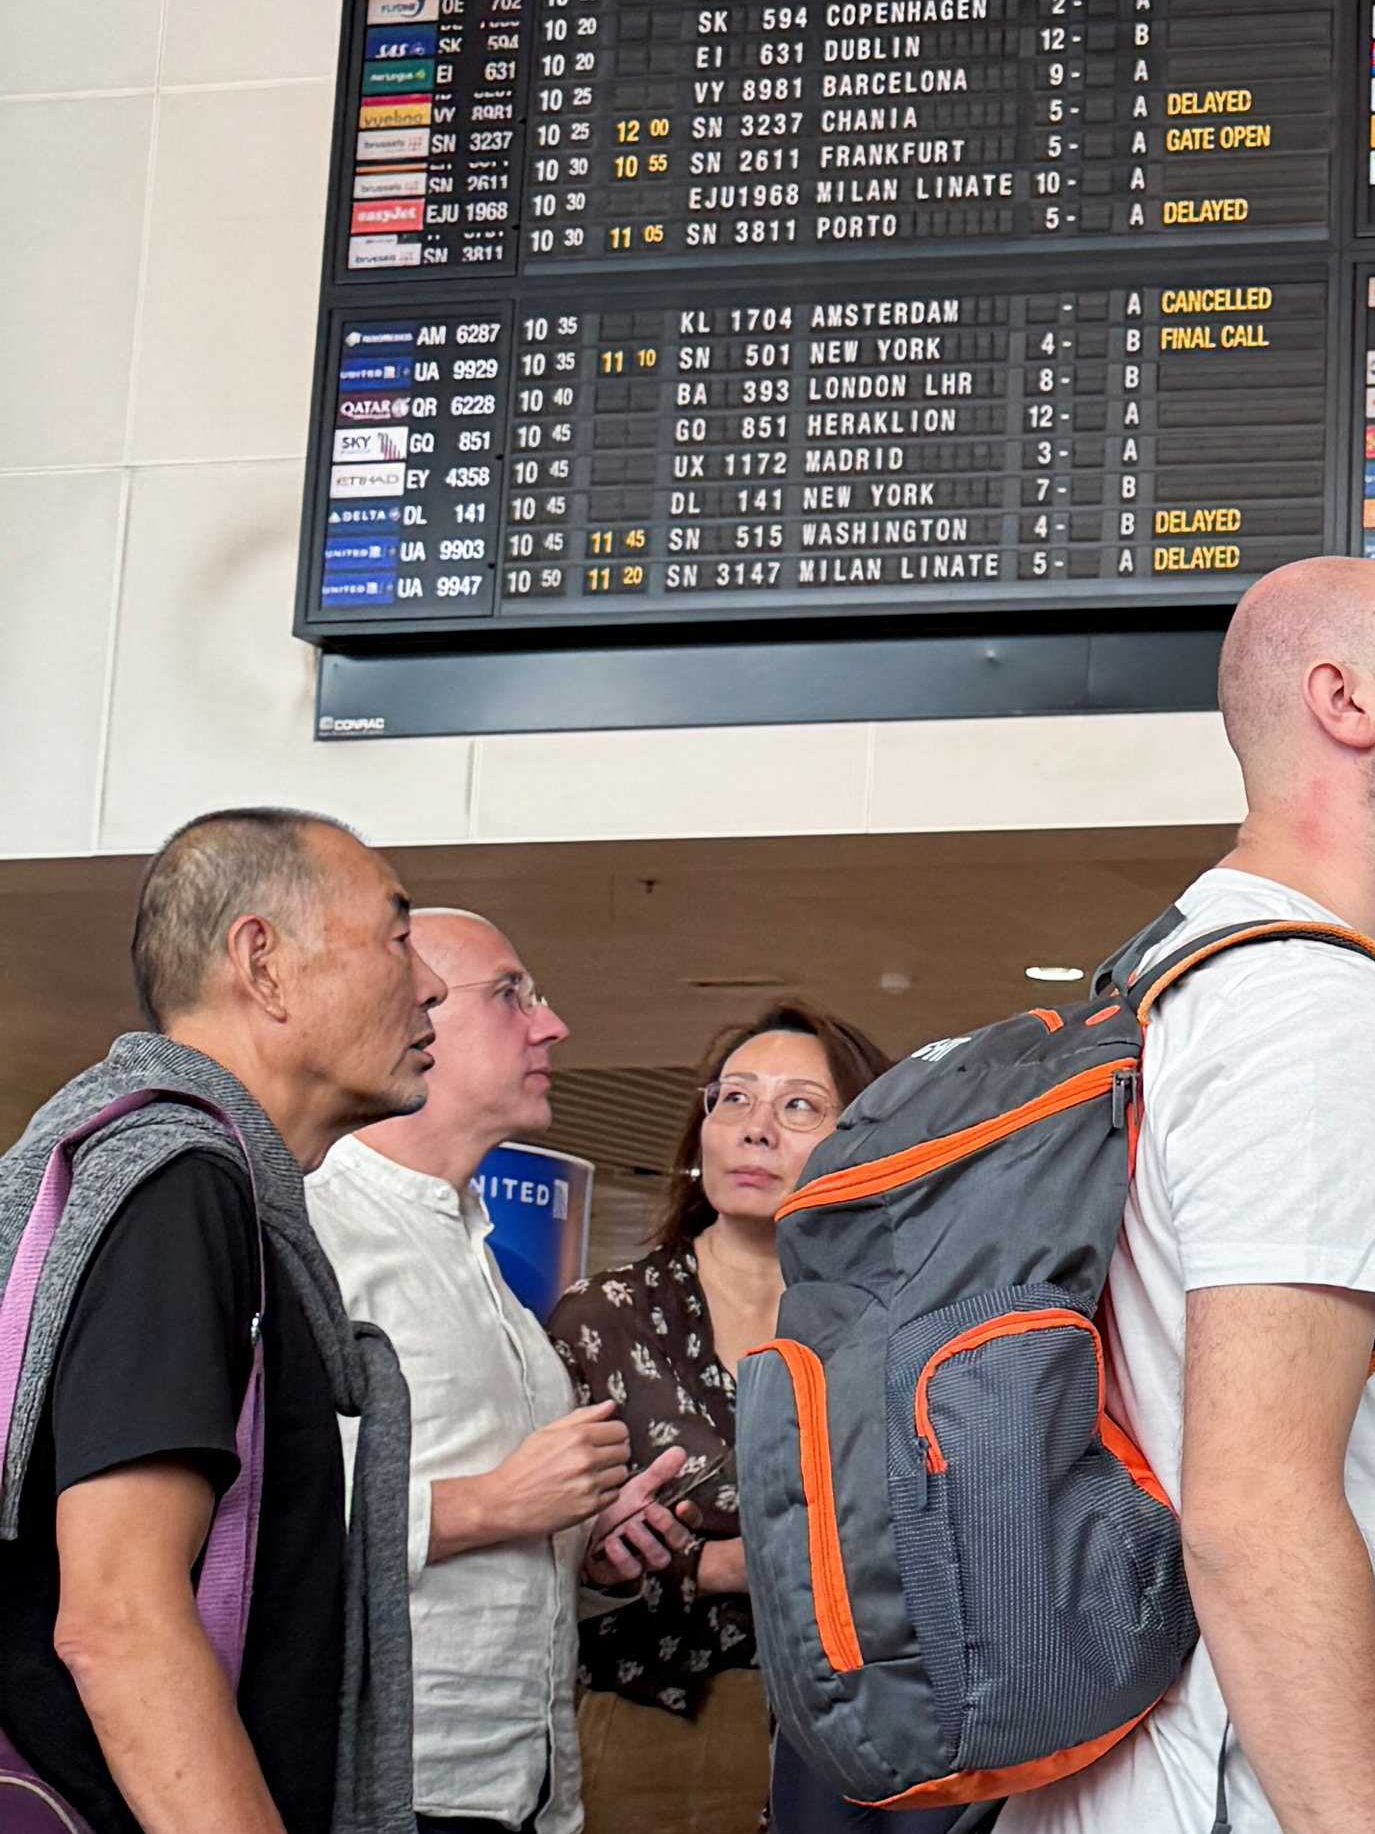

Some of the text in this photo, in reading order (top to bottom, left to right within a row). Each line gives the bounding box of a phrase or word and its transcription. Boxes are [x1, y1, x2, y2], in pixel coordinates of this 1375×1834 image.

[823, 69, 966, 97] BARCELONA
[822, 90, 1251, 132] CHANIA DELAYED
[821, 125, 1270, 167] FRANKFURT GATE OPEN
[817, 199, 1248, 238] PORTO DELAYED
[812, 287, 1272, 327] AMSTERDAM CANCELLED
[811, 325, 1269, 363] NEW YORK FINAL CALL
[340, 400, 391, 416] QATAR
[808, 409, 955, 435] HERAKLION
[342, 435, 371, 449] SKY
[806, 447, 902, 471] MADRID
[343, 510, 385, 522] DELTA
[803, 519, 966, 544] WASHINGTON
[1155, 546, 1240, 569] DELAYED
[469, 1175, 549, 1206] NITED
